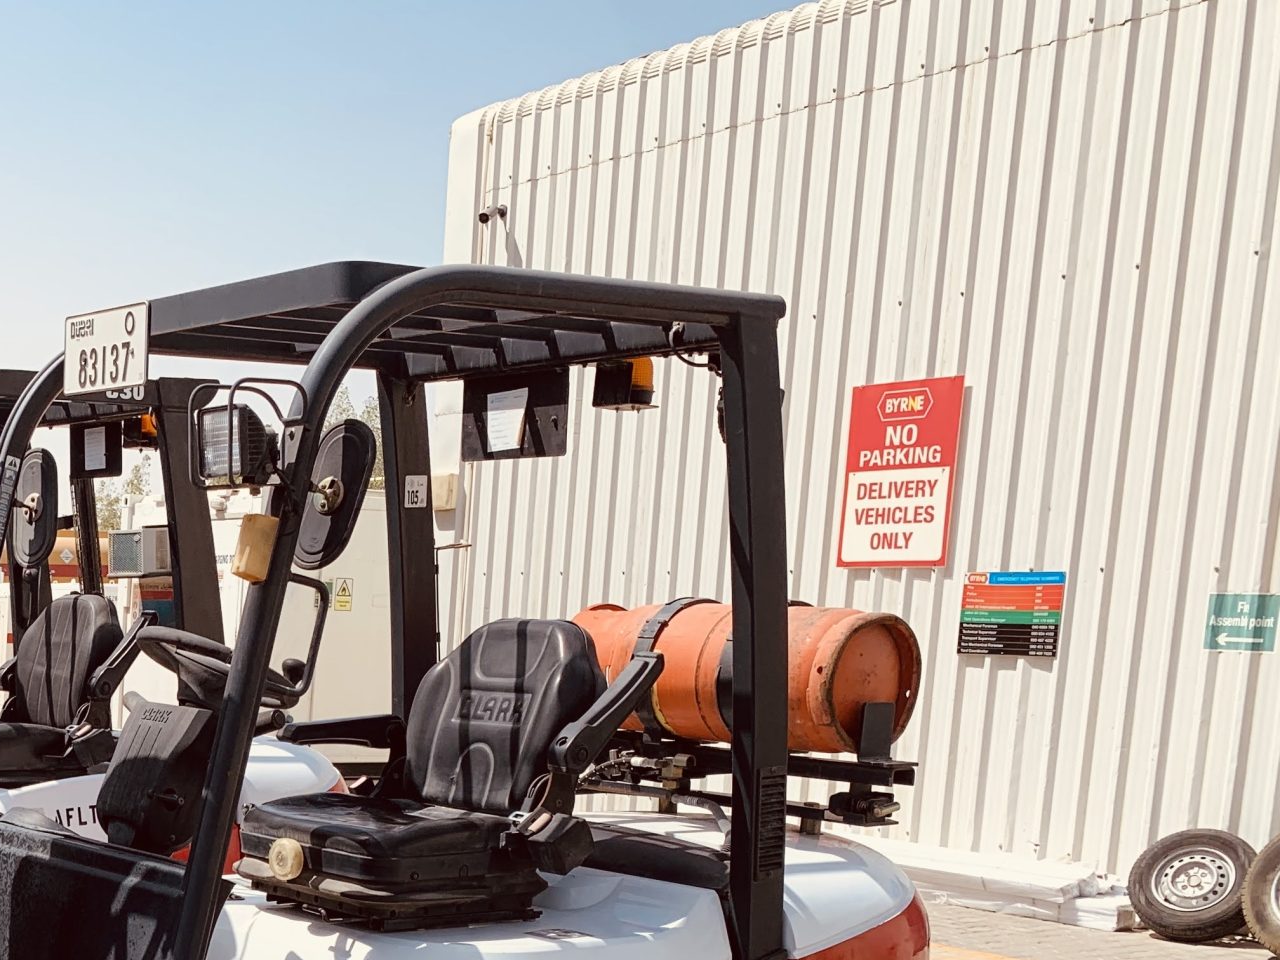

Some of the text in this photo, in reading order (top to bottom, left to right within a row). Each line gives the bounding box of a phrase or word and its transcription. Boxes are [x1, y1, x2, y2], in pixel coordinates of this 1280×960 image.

[79, 341, 131, 389] 83137
[885, 395, 925, 414] BYRNE
[885, 423, 918, 447] NO
[859, 445, 942, 468] PARKING
[856, 479, 938, 501] DELIVERY
[855, 505, 935, 526] VEHICLES
[870, 532, 913, 550] ONLY
[1248, 615, 1275, 631] point
[456, 695, 524, 722] CLARK
